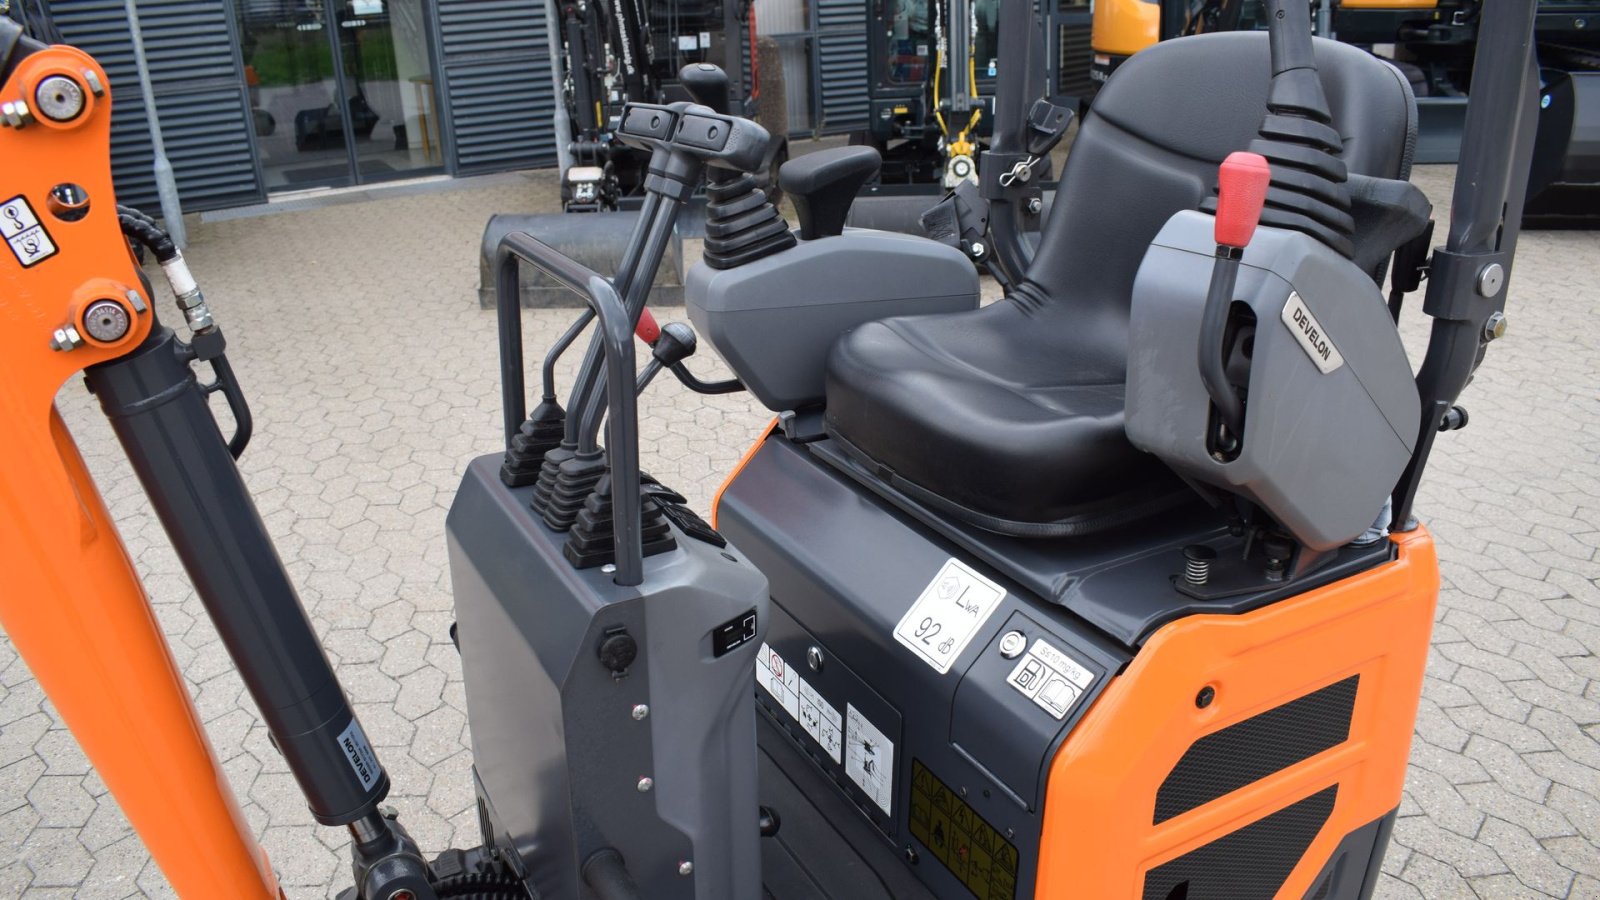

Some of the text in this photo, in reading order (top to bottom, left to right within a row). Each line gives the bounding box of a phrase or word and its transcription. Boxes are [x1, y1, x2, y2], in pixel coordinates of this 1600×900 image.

[1293, 307, 1331, 361] DEVELON
[914, 616, 955, 655] 92 dB
[343, 737, 371, 783] DEVELON
